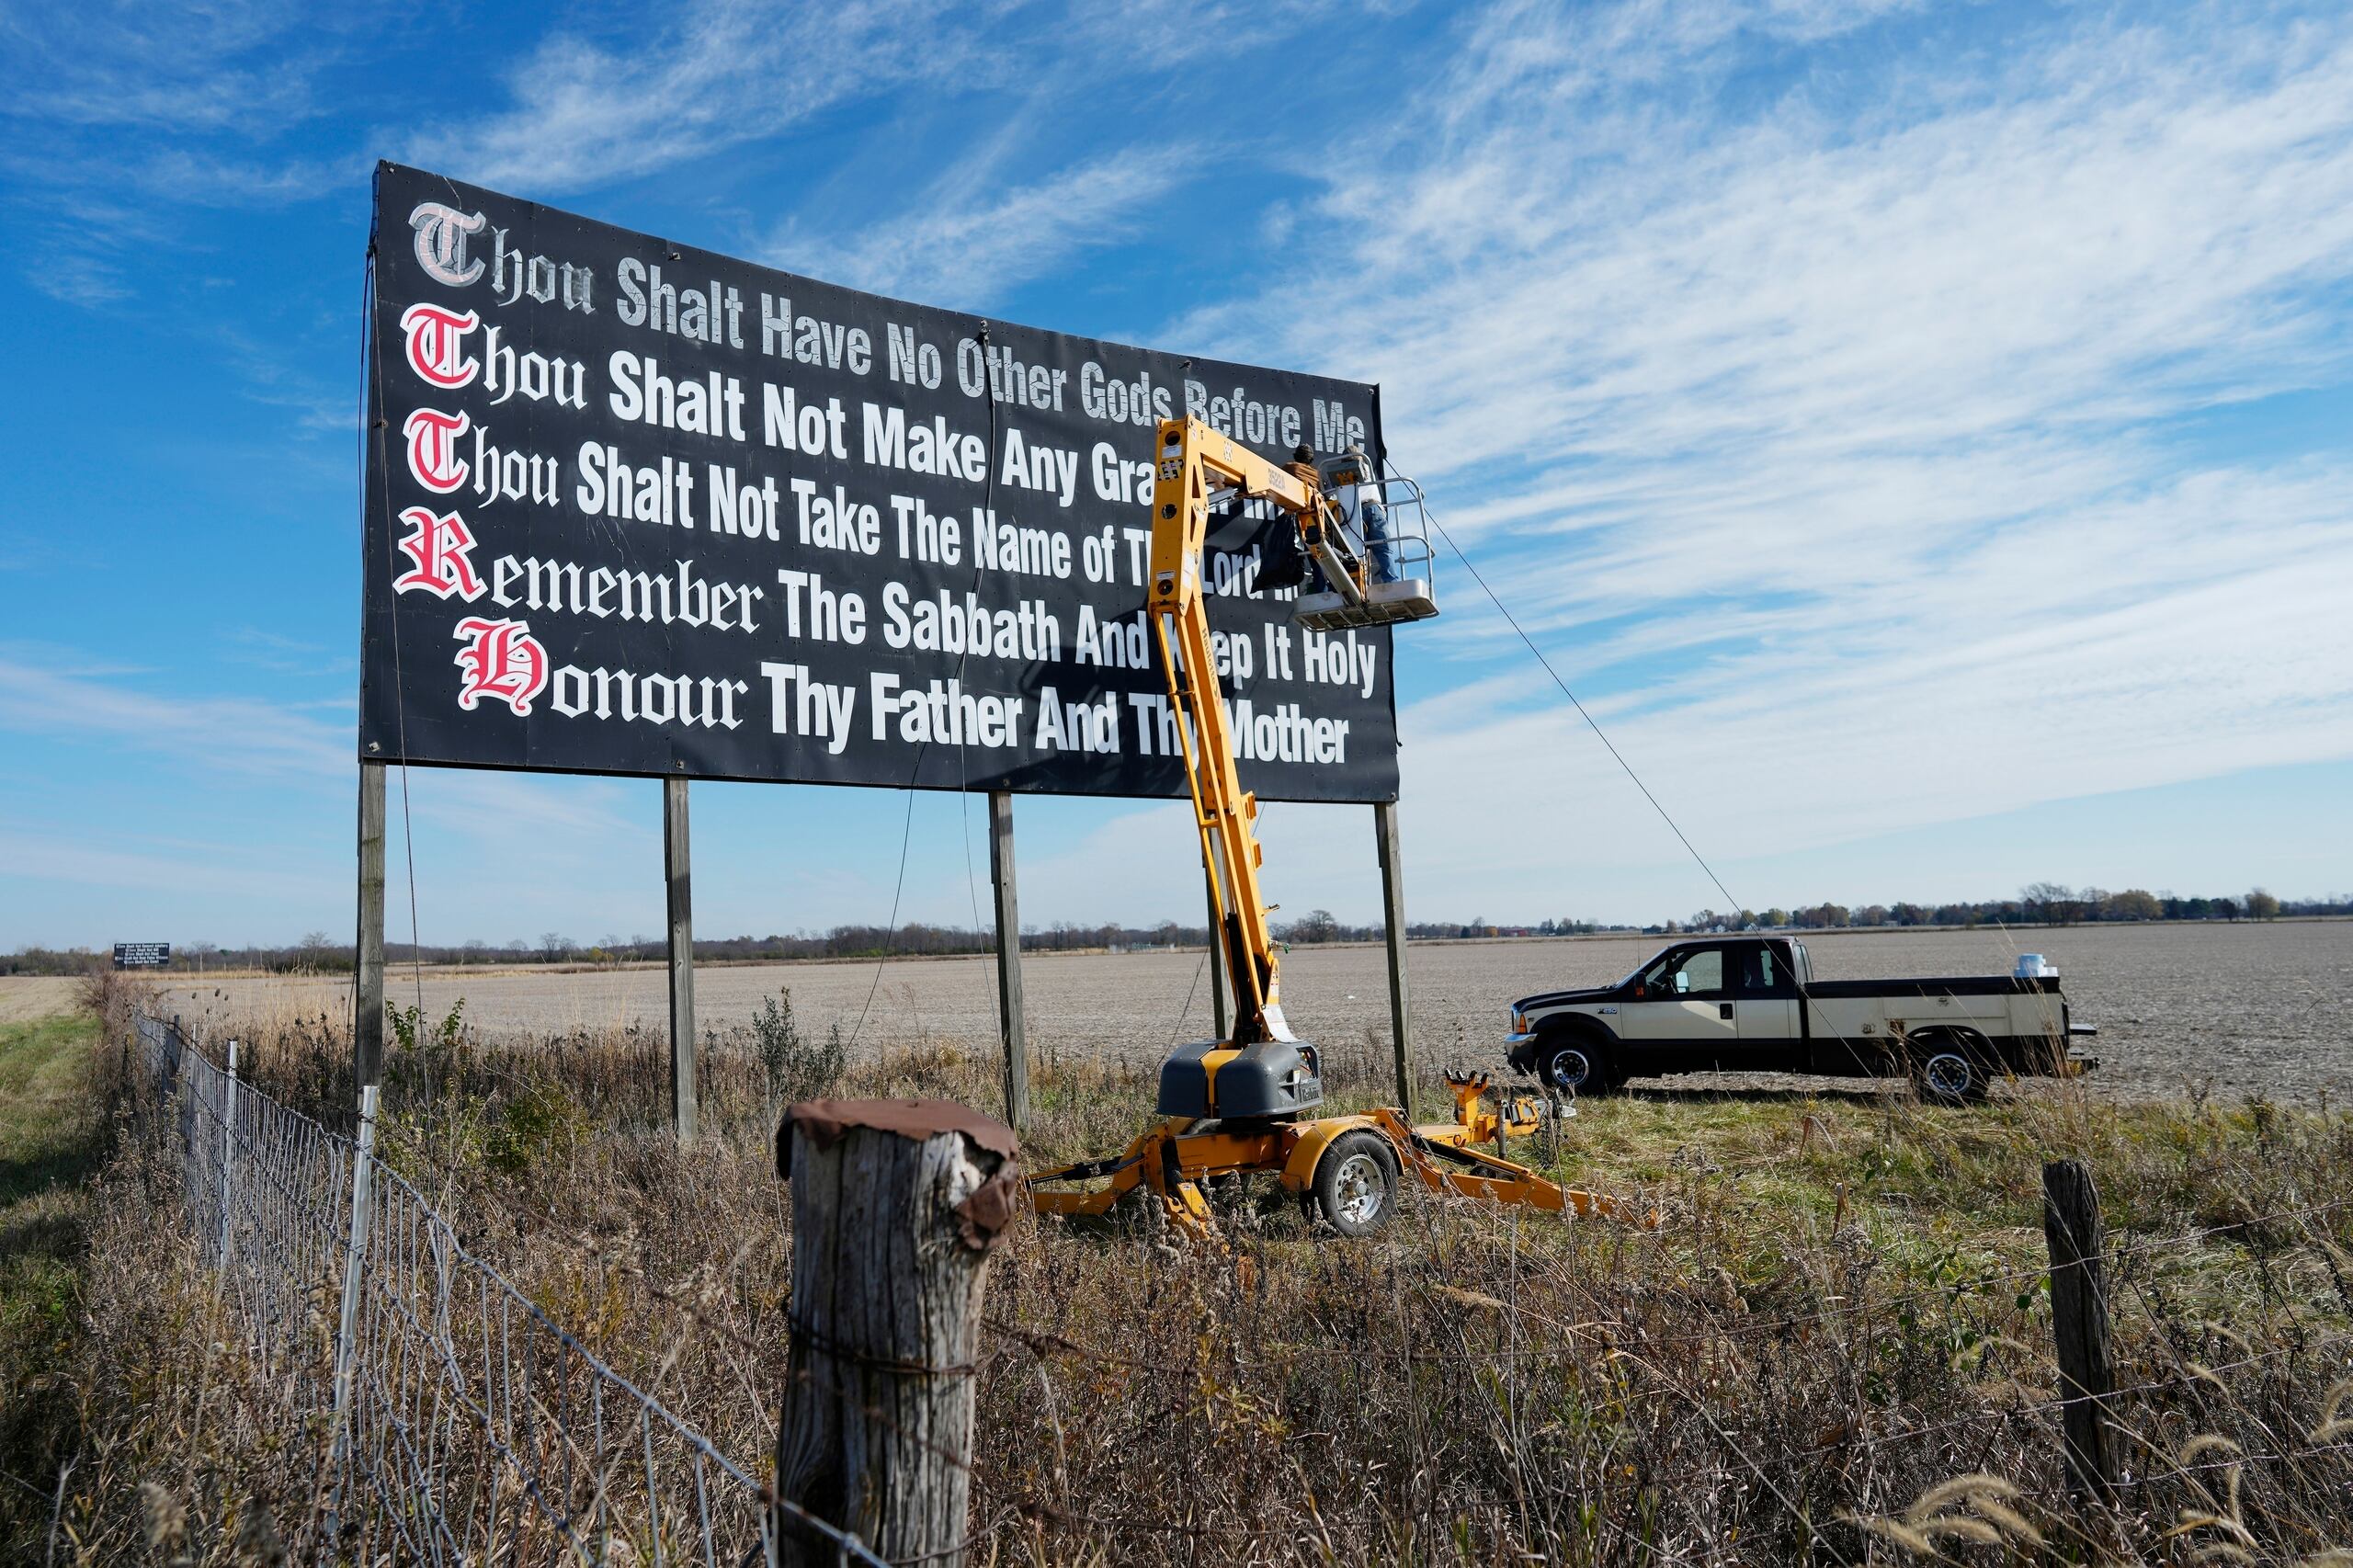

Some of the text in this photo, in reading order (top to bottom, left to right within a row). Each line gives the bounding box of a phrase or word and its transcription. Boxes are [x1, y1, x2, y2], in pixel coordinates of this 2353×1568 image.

[399, 302, 587, 410] Thou
[608, 350, 745, 443] Shalt
[763, 381, 847, 460] Not
[863, 402, 987, 483] Make
[1001, 428, 1077, 508] Any
[408, 201, 1365, 454] Thou Shalt Have No Other Gods Before Me
[403, 407, 559, 508] Thou
[576, 441, 694, 528] Shalt
[709, 463, 779, 541] Not
[790, 477, 880, 555] Take
[891, 494, 961, 566] The
[972, 506, 1072, 579] Name
[1083, 525, 1115, 583] of
[392, 506, 764, 634] Remember
[778, 568, 866, 644] The
[882, 581, 1061, 662] Sabbath
[1075, 604, 1150, 669] And
[1265, 623, 1292, 681] It
[1303, 630, 1376, 699] Holy
[453, 616, 748, 730] Honour
[761, 661, 856, 755] Thy
[870, 672, 1023, 748] Father
[1035, 686, 1120, 754] And
[1222, 699, 1349, 764] Mother
